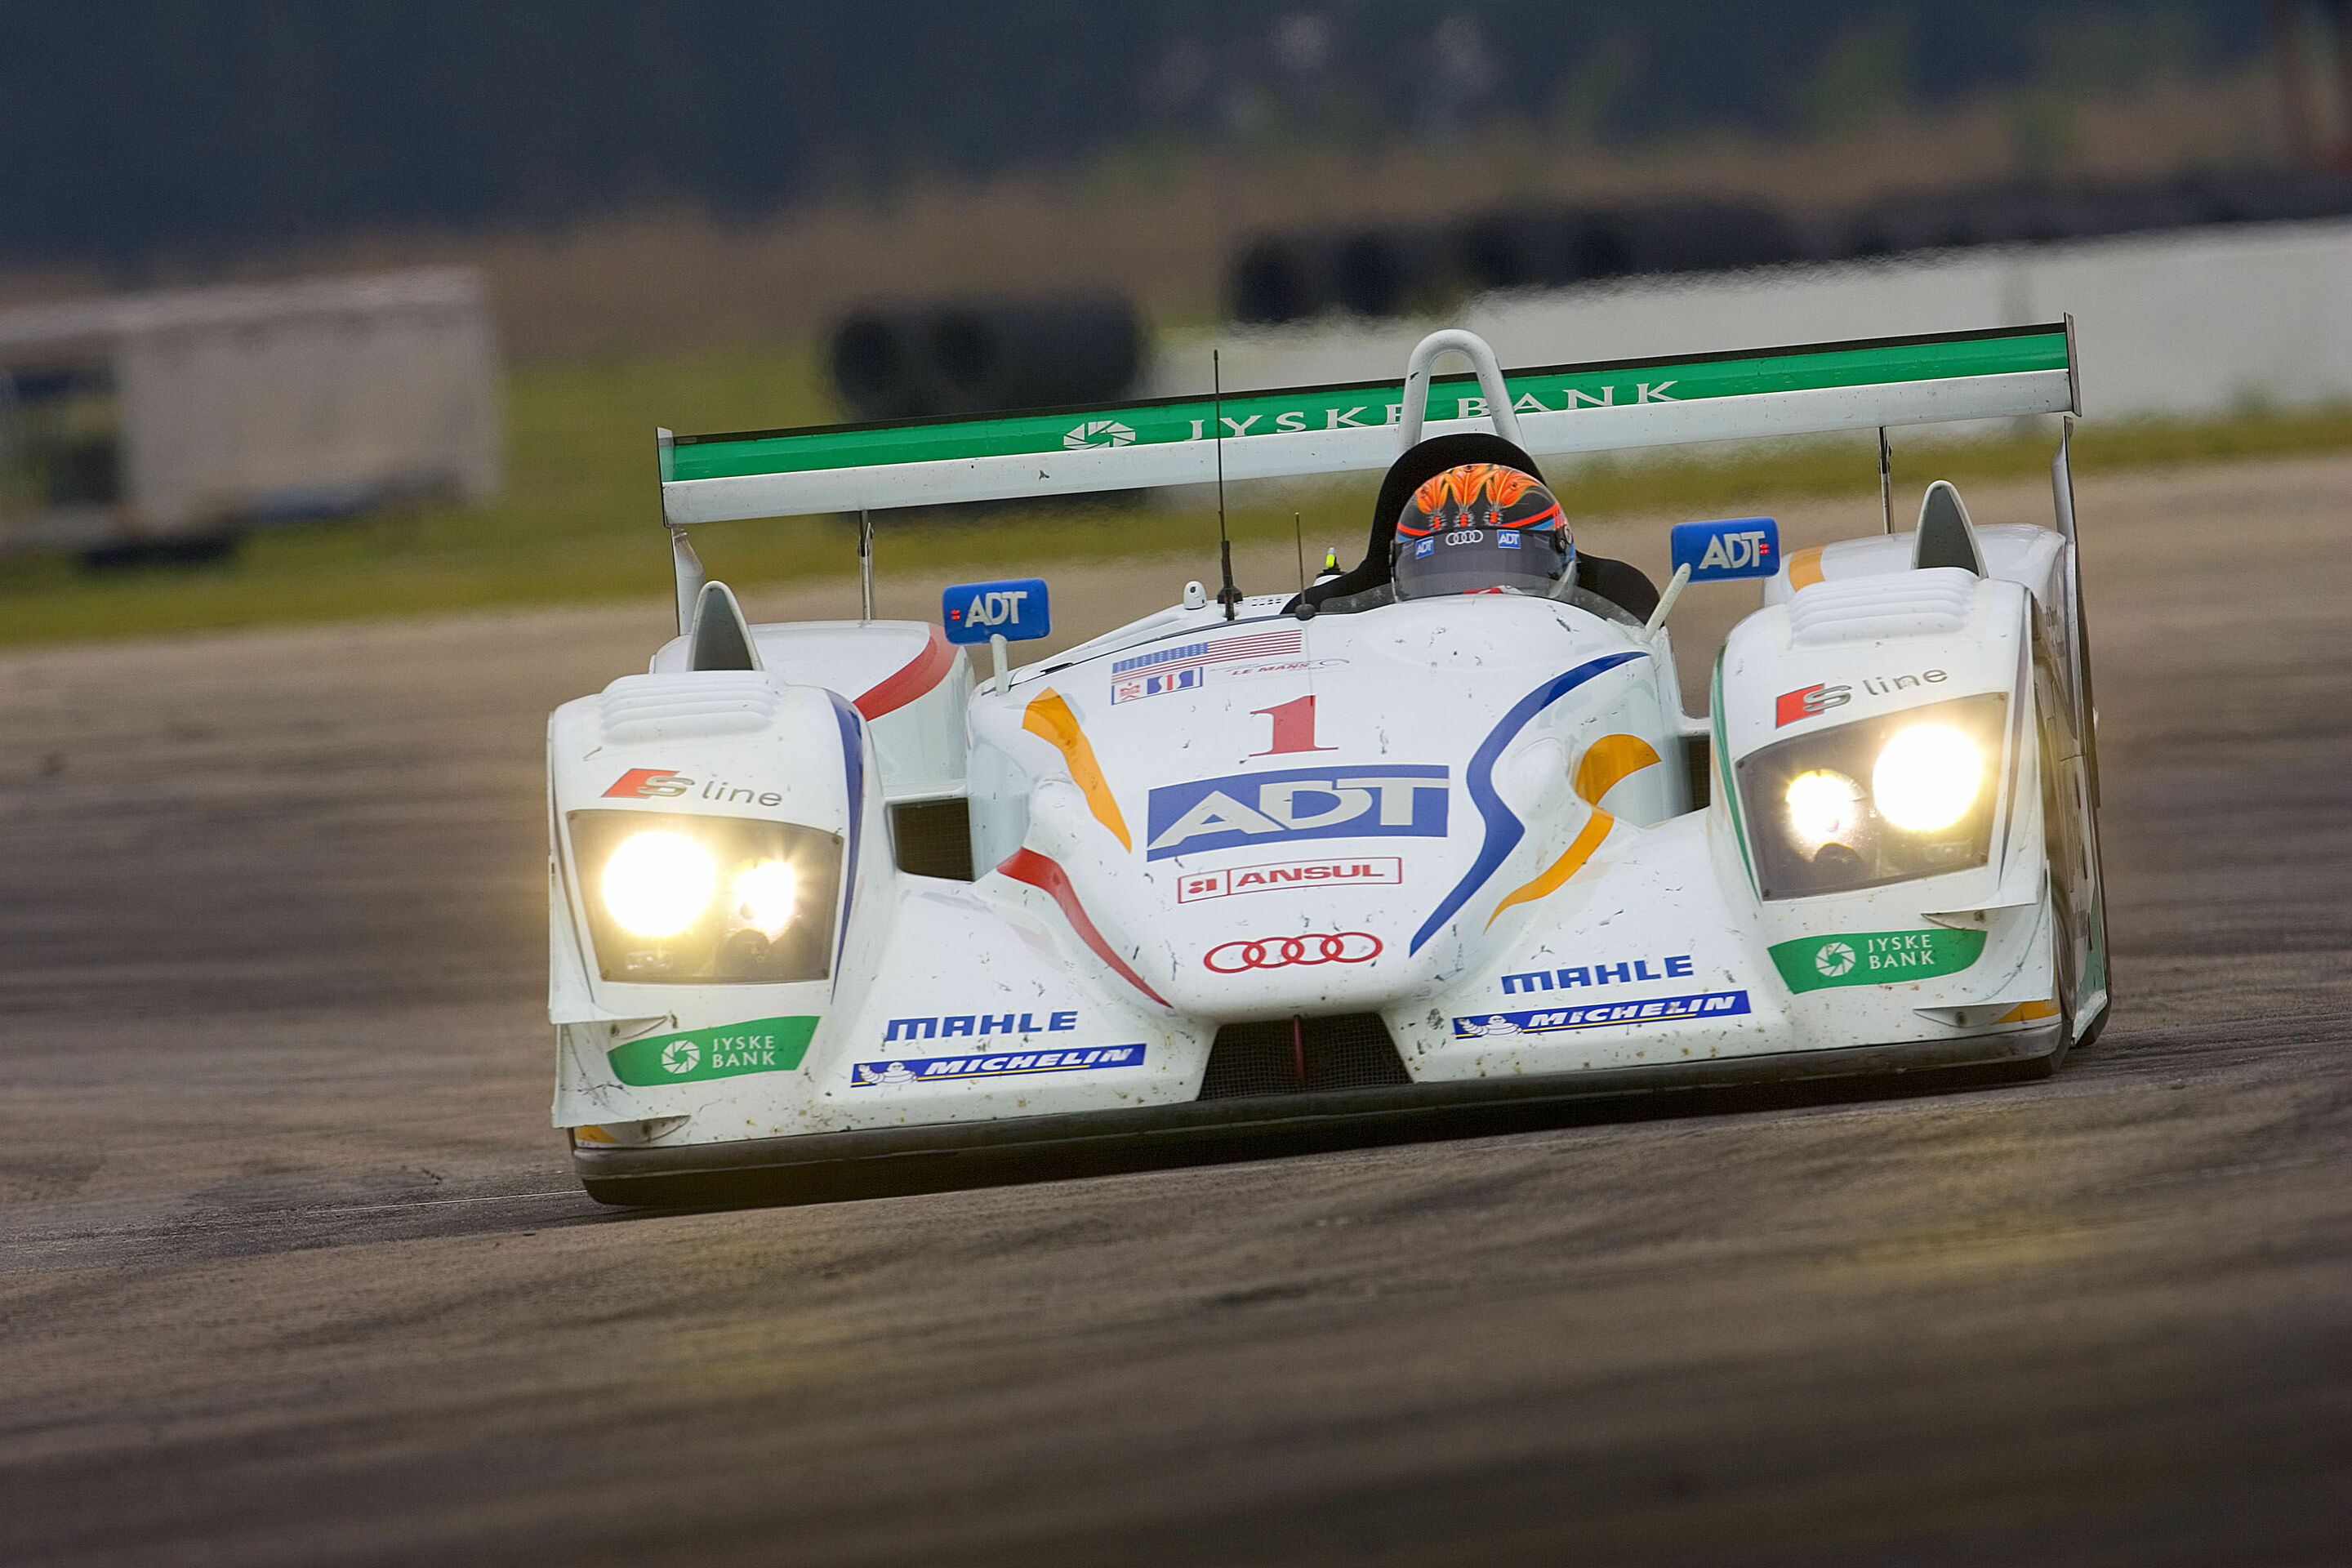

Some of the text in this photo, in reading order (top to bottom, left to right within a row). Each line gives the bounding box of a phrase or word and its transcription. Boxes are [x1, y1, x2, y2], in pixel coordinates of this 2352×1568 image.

[1457, 380, 1681, 419] BANK
[1416, 540, 1432, 555] ADT
[1498, 534, 1519, 546] ADT
[1699, 531, 1766, 570] ADT
[964, 591, 1027, 627] ADT
[1258, 662, 1312, 672] MANS
[1803, 669, 1949, 713] S line
[1249, 695, 1339, 757] 1
[637, 776, 782, 807] S line
[1147, 777, 1450, 850] ADT
[1236, 865, 1384, 887] ANSUL
[1868, 934, 1933, 953] JYSKE
[1501, 955, 1694, 995] MAHLE
[1869, 951, 1936, 969] BANK
[885, 1011, 1078, 1041] MAHLE
[1527, 996, 1736, 1027] MICHELIN
[713, 1036, 775, 1052] JYSKE
[712, 1051, 776, 1068] BANK
[924, 1048, 1134, 1076] MICHELIN
